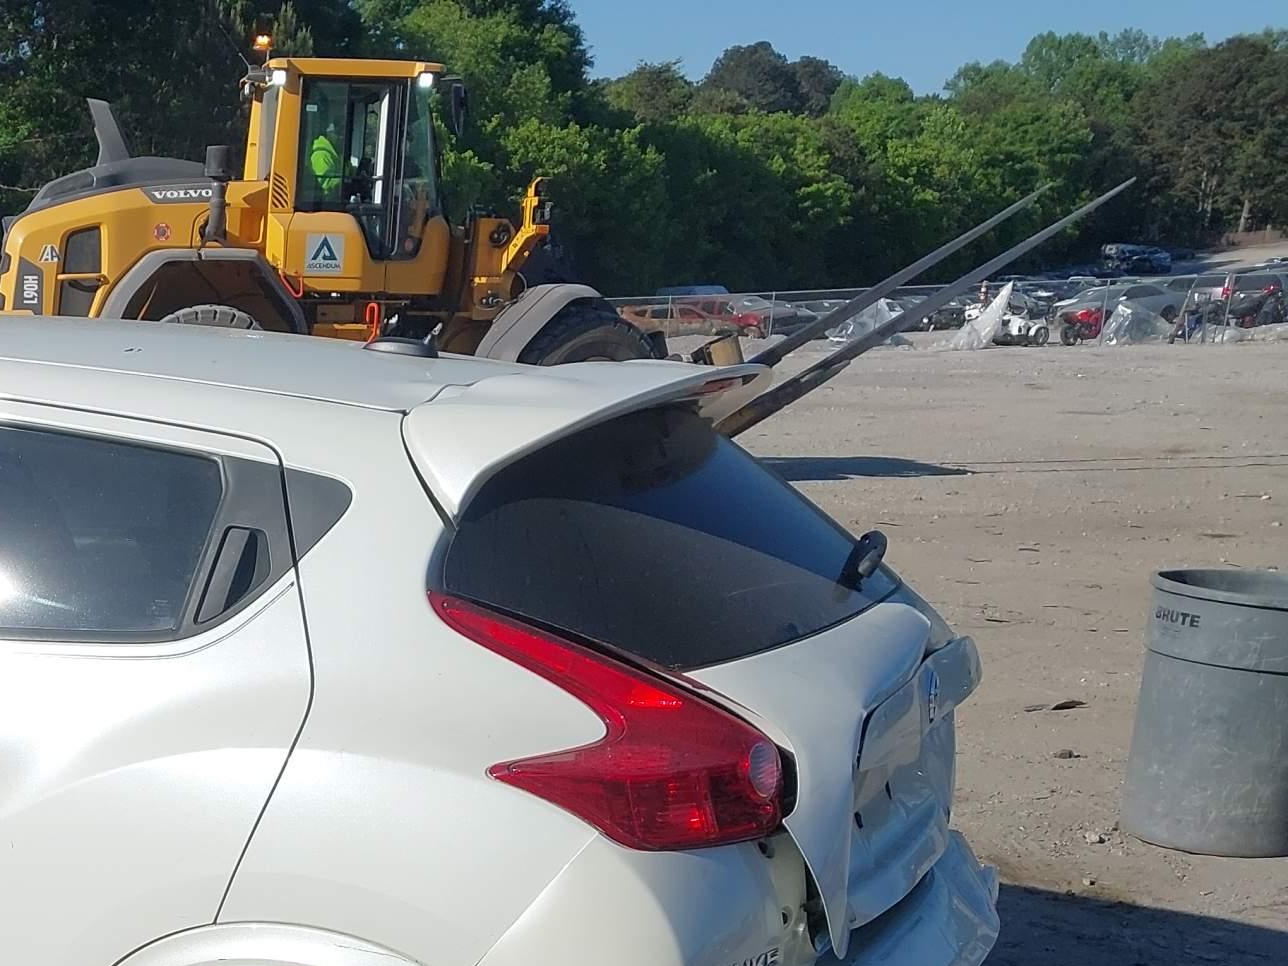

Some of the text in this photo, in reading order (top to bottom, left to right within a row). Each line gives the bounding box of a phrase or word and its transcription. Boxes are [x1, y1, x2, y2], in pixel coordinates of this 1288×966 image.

[152, 189, 212, 199] VOLVO
[23, 275, 39, 304] L90H
[1155, 606, 1201, 628] BRUTE
